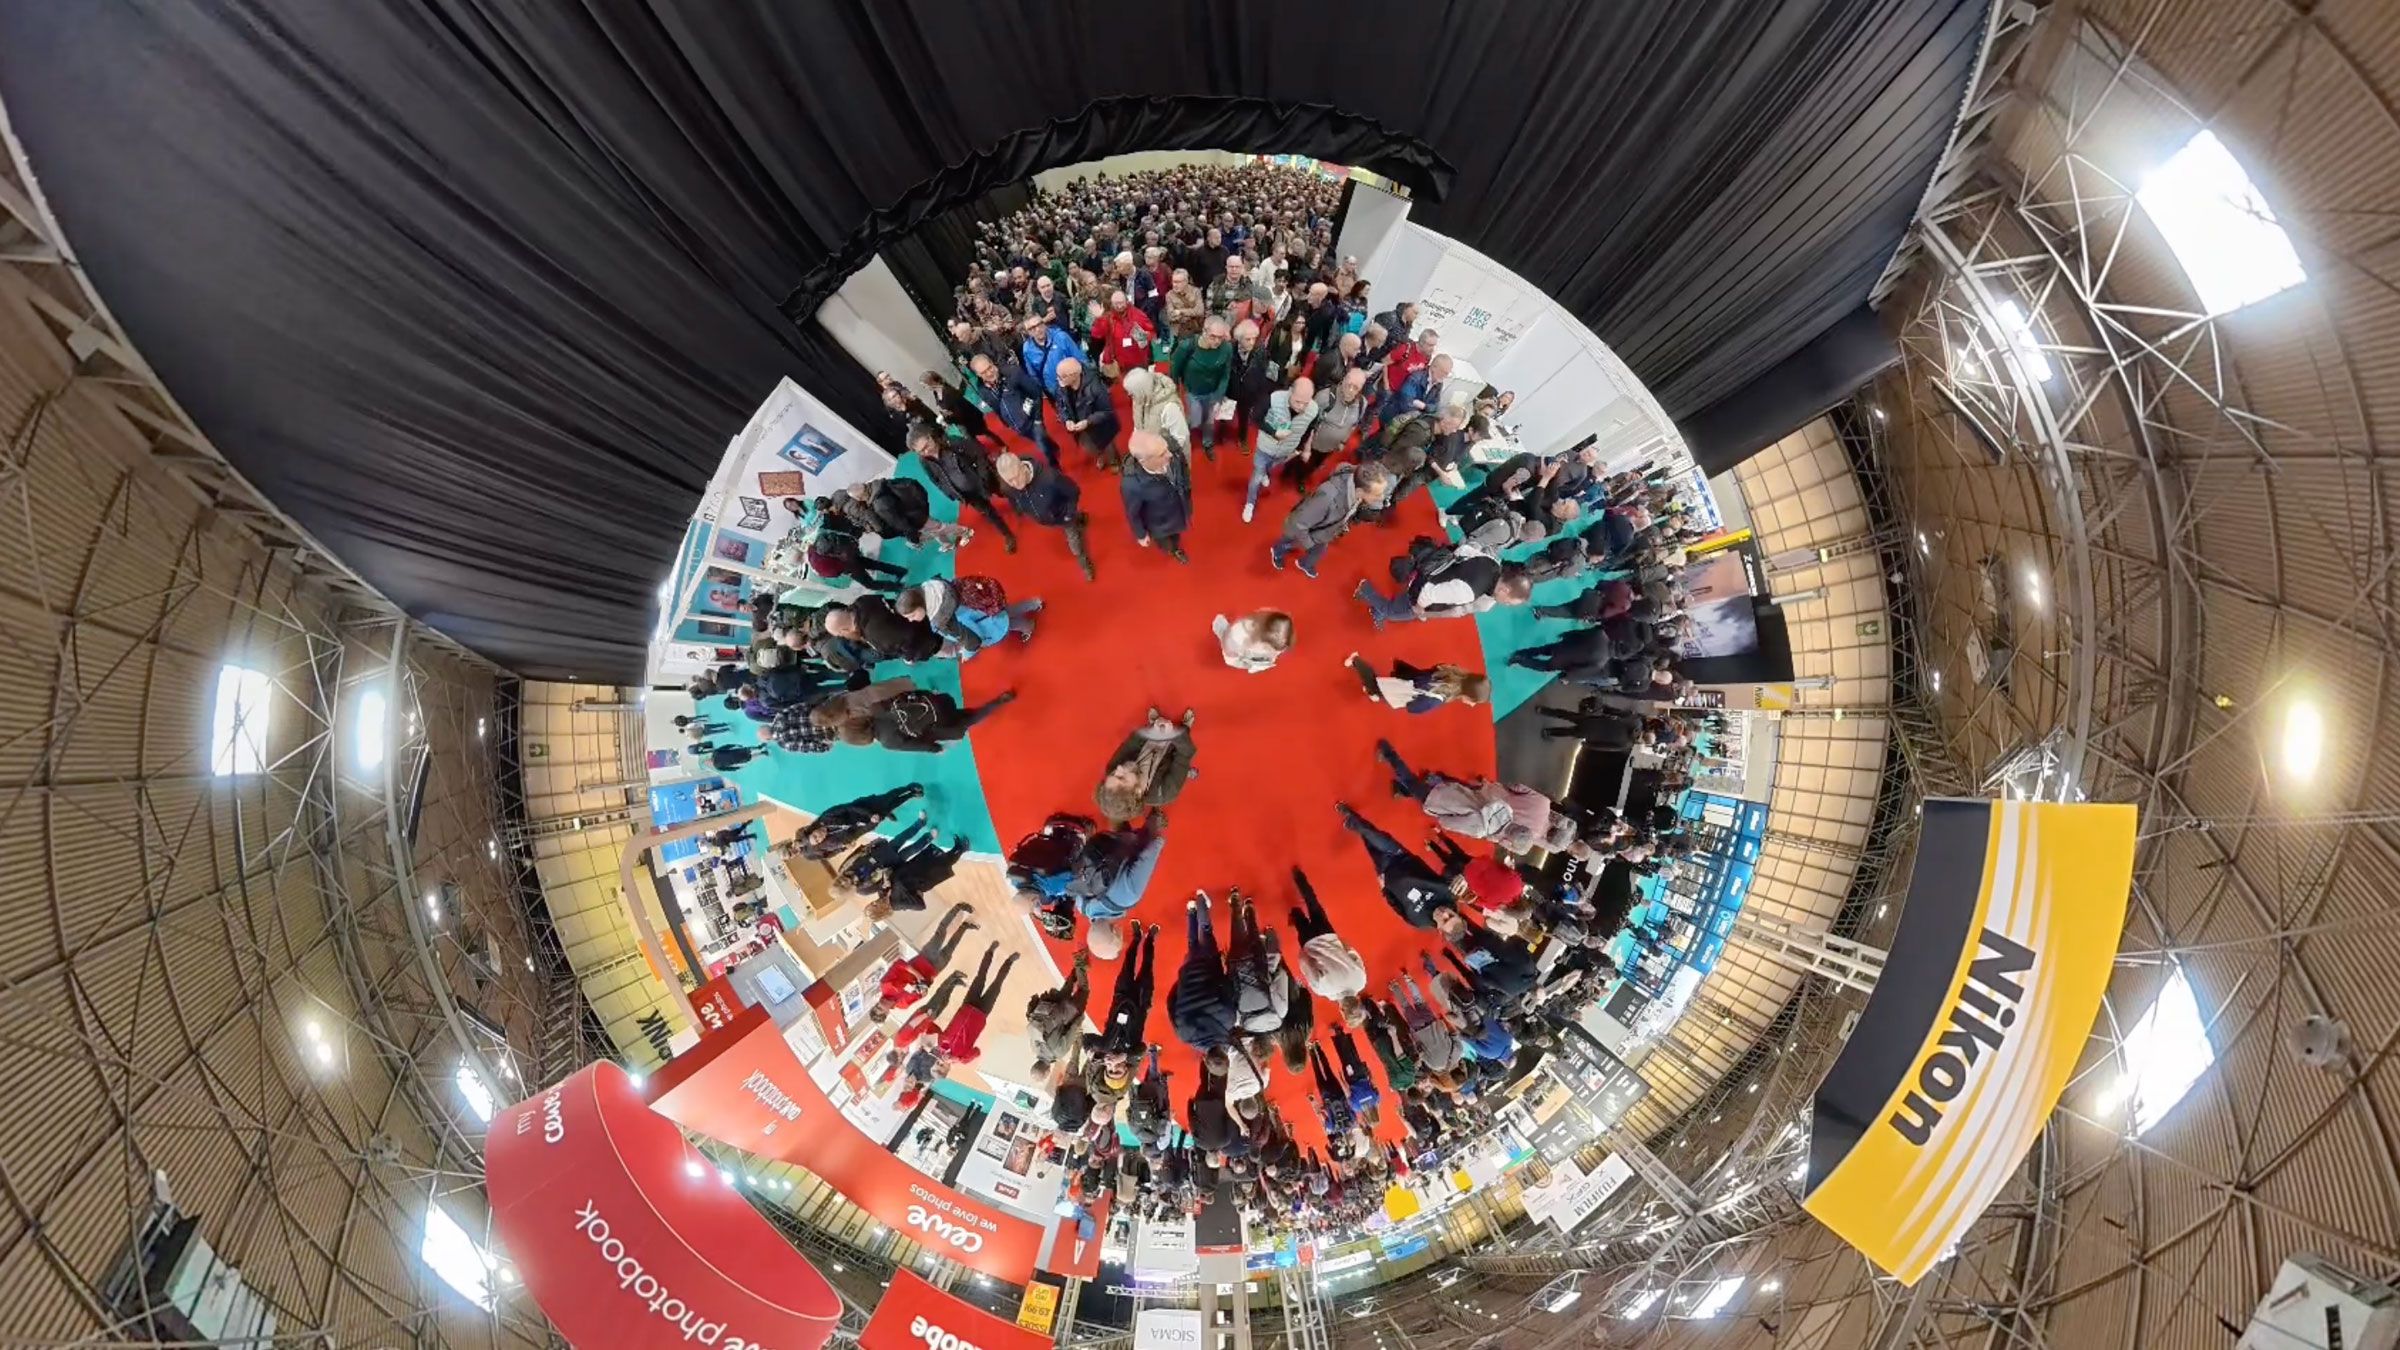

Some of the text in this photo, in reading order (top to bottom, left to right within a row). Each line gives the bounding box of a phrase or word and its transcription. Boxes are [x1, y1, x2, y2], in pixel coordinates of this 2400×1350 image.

[1462, 315, 1488, 331] DESK
[1469, 306, 1492, 322] INFO
[701, 1002, 724, 1029] we
[1888, 926, 2037, 1147] Nikon
[516, 1110, 536, 1136] my
[909, 1183, 998, 1233] we love photos
[1573, 1176, 1618, 1217] FUJIFILM
[907, 1204, 984, 1253] cewe
[574, 1198, 728, 1347] photobook
[910, 1314, 984, 1350] obe
[1150, 1327, 1196, 1343] SIGMA
